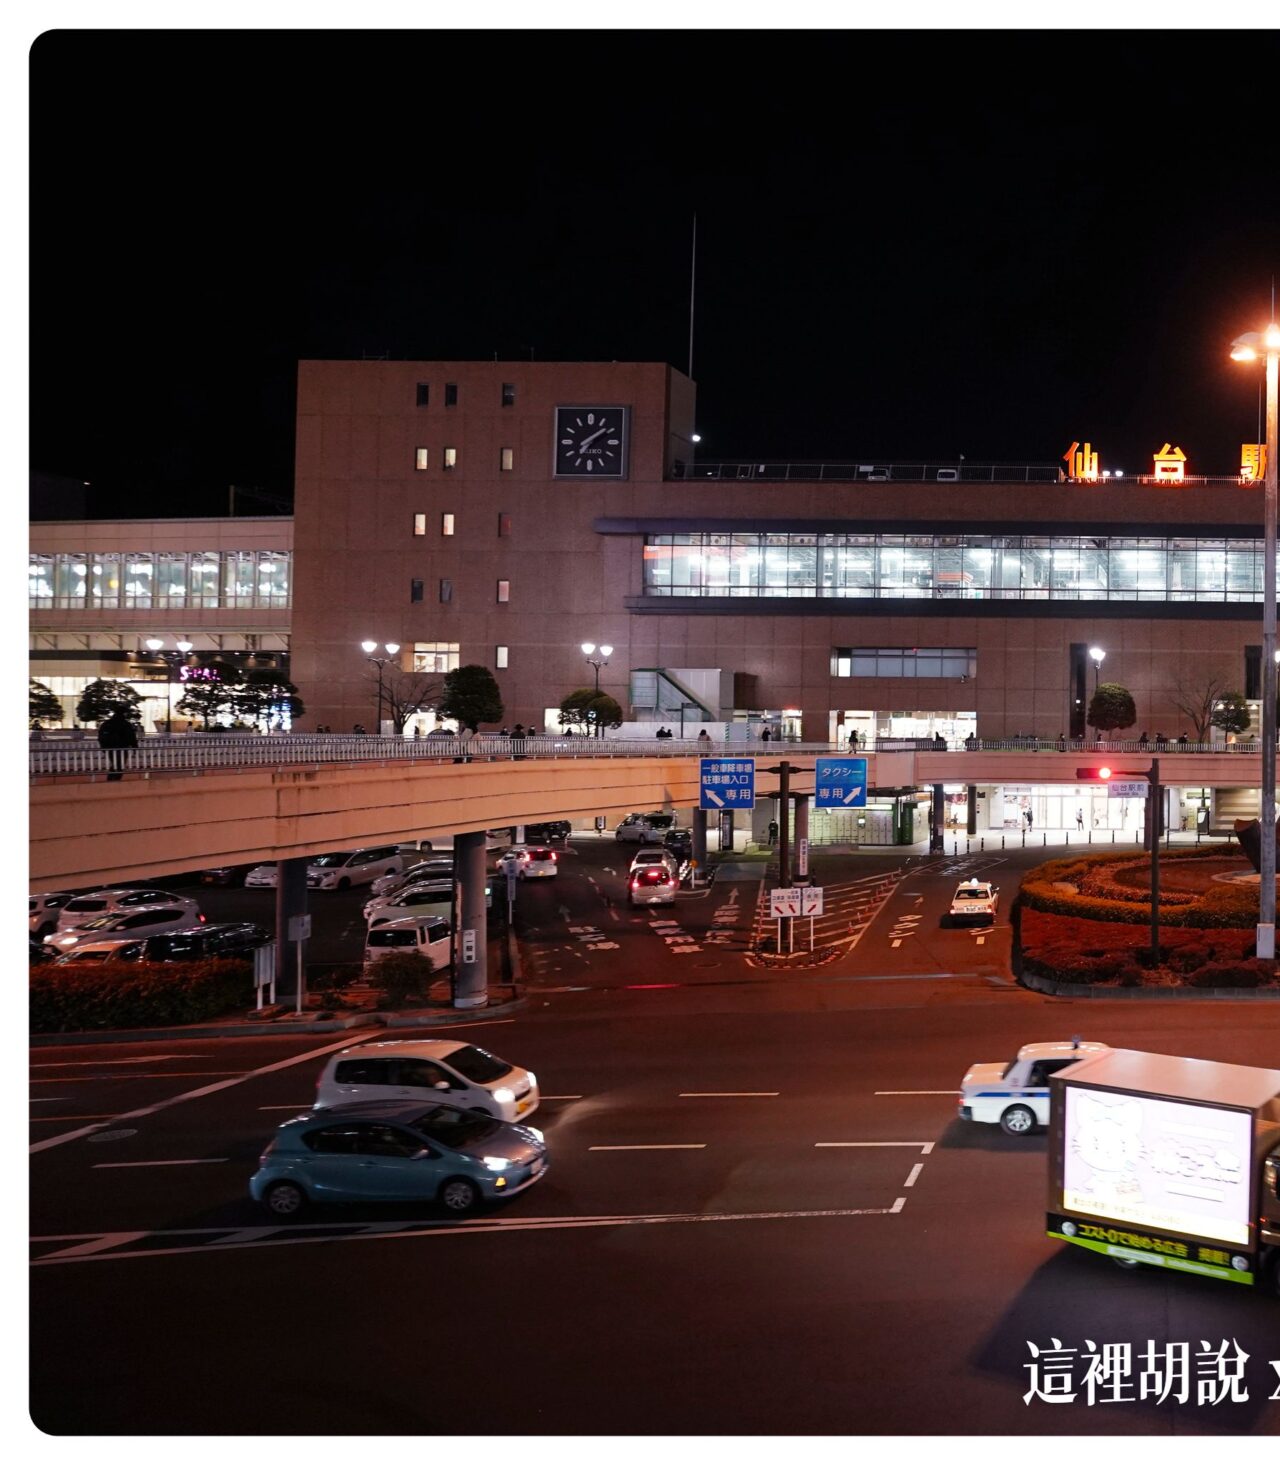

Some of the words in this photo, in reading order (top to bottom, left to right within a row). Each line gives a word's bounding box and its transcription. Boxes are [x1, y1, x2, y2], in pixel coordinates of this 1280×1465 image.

[822, 767, 863, 777] タクシー
[702, 775, 749, 785] 駐車場入口
[1112, 783, 1145, 792] 仙台駅前
[725, 789, 751, 799] 専用
[819, 788, 844, 799] 専用
